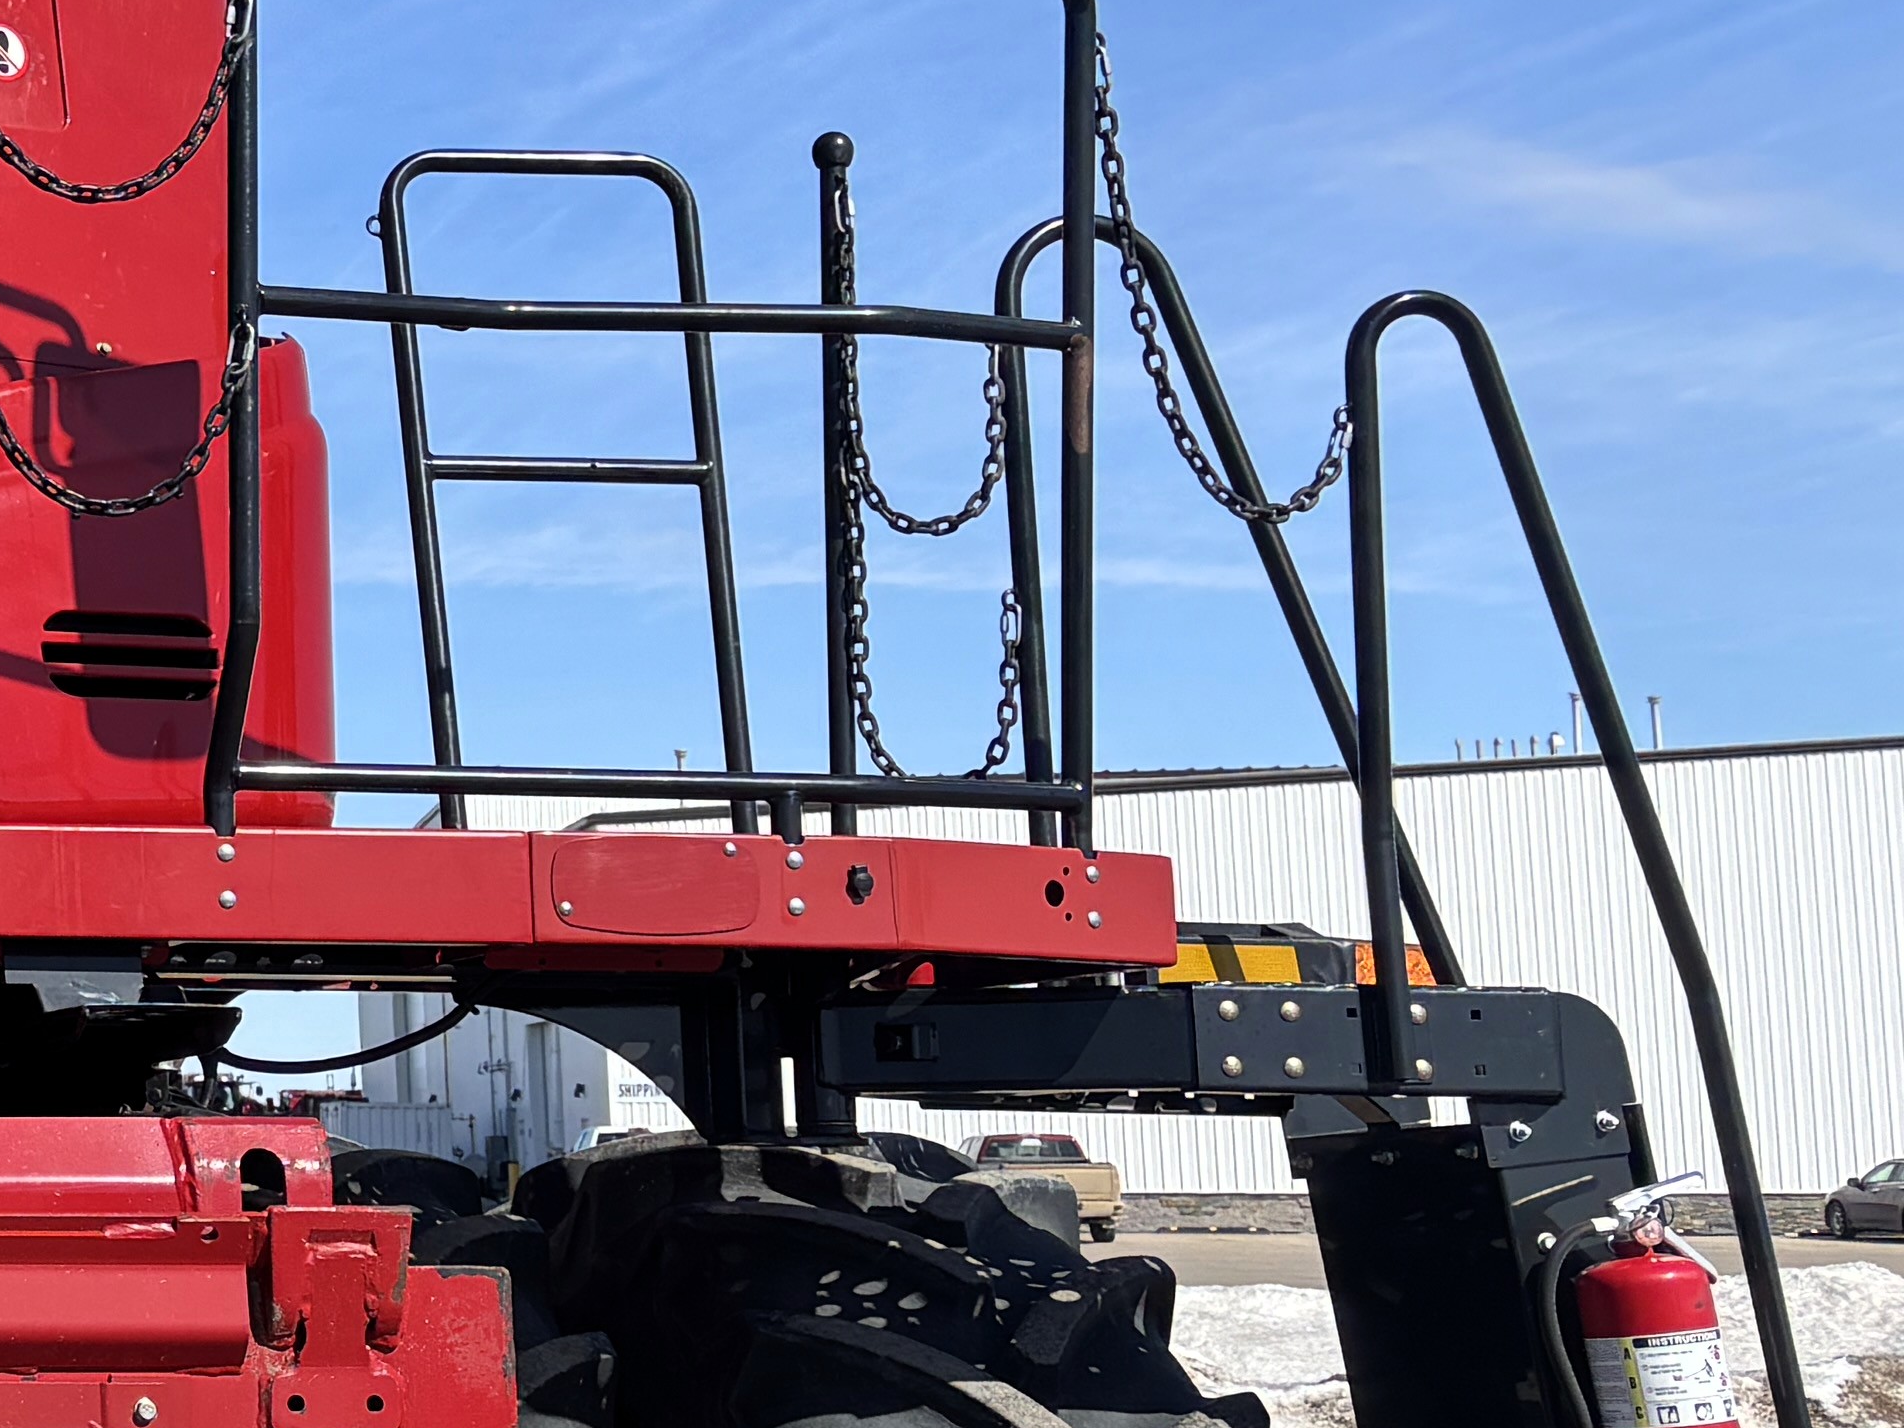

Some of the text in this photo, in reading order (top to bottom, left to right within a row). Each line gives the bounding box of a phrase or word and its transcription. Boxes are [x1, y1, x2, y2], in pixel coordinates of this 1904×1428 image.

[1623, 1347, 1632, 1360] A
[1629, 1376, 1637, 1389] B
[1635, 1406, 1644, 1420] C
